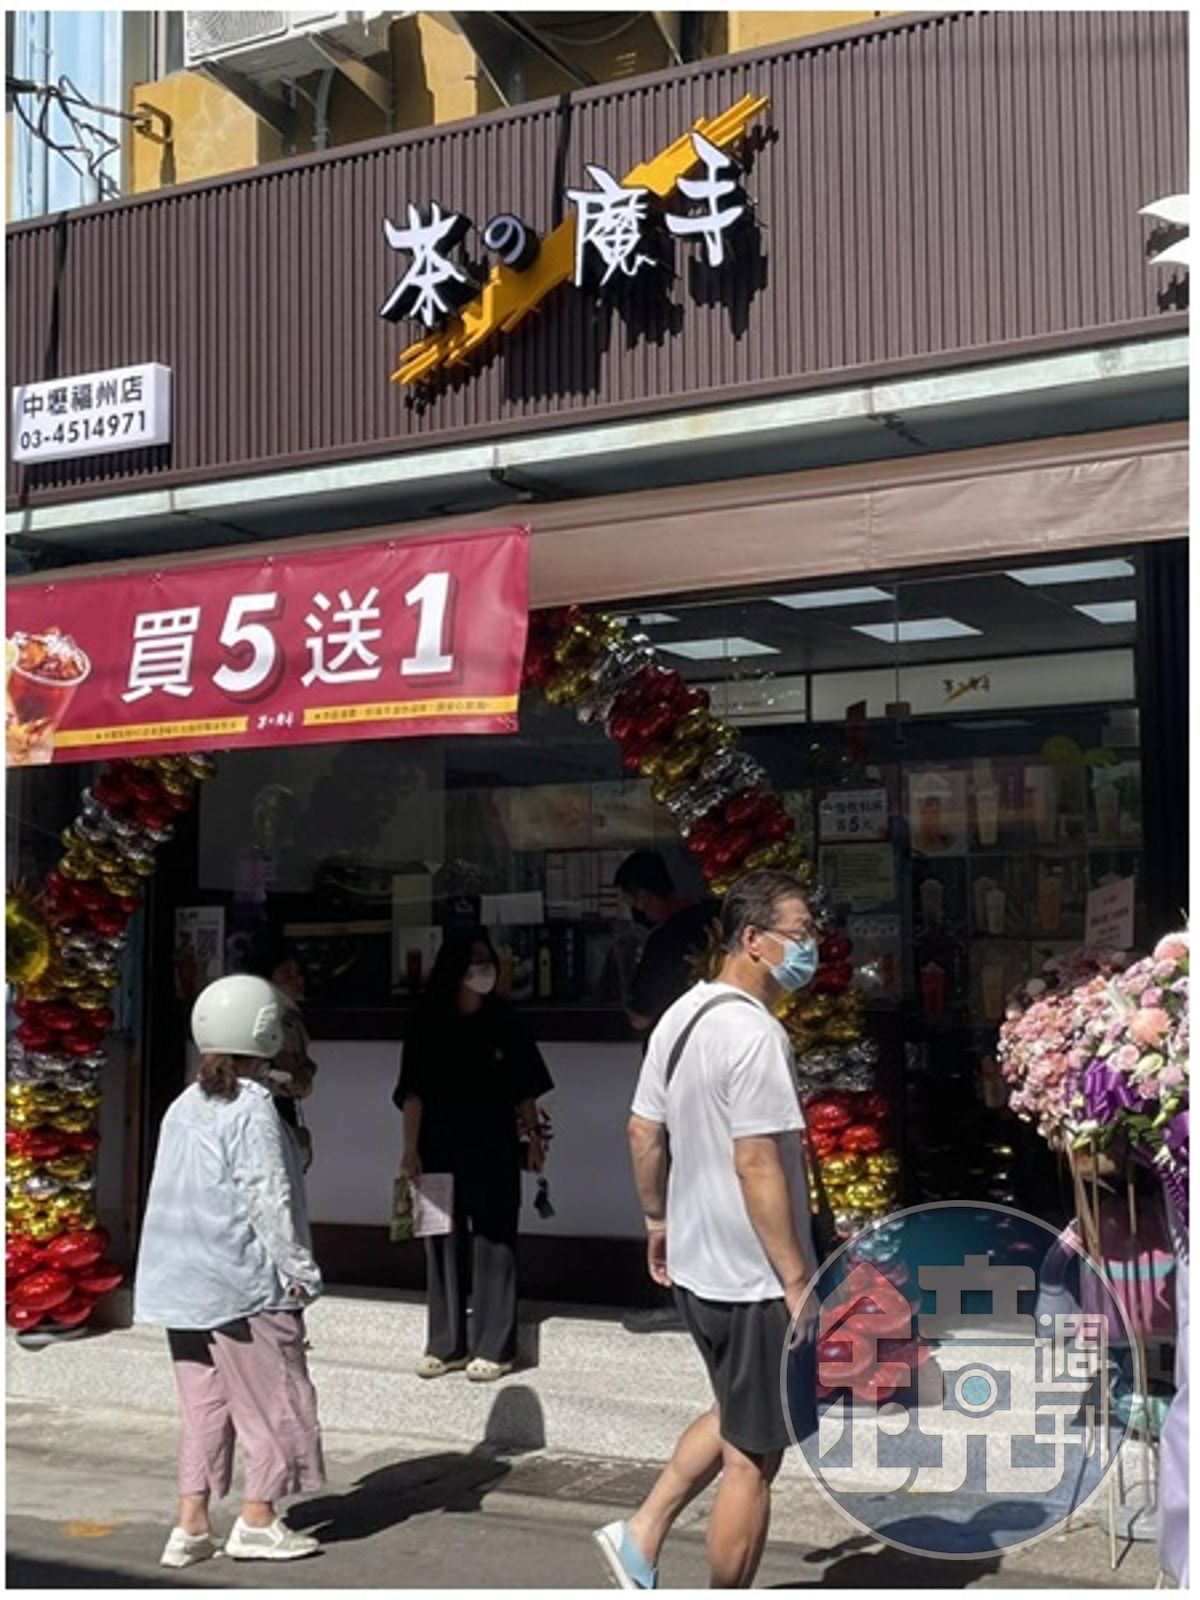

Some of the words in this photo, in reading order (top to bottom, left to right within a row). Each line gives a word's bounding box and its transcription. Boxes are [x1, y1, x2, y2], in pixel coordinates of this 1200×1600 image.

[381, 132, 743, 327] 茶の魔手
[20, 411, 145, 449] 03-4514971
[23, 376, 142, 418] 中壢福州店
[122, 572, 455, 703] 買5送1
